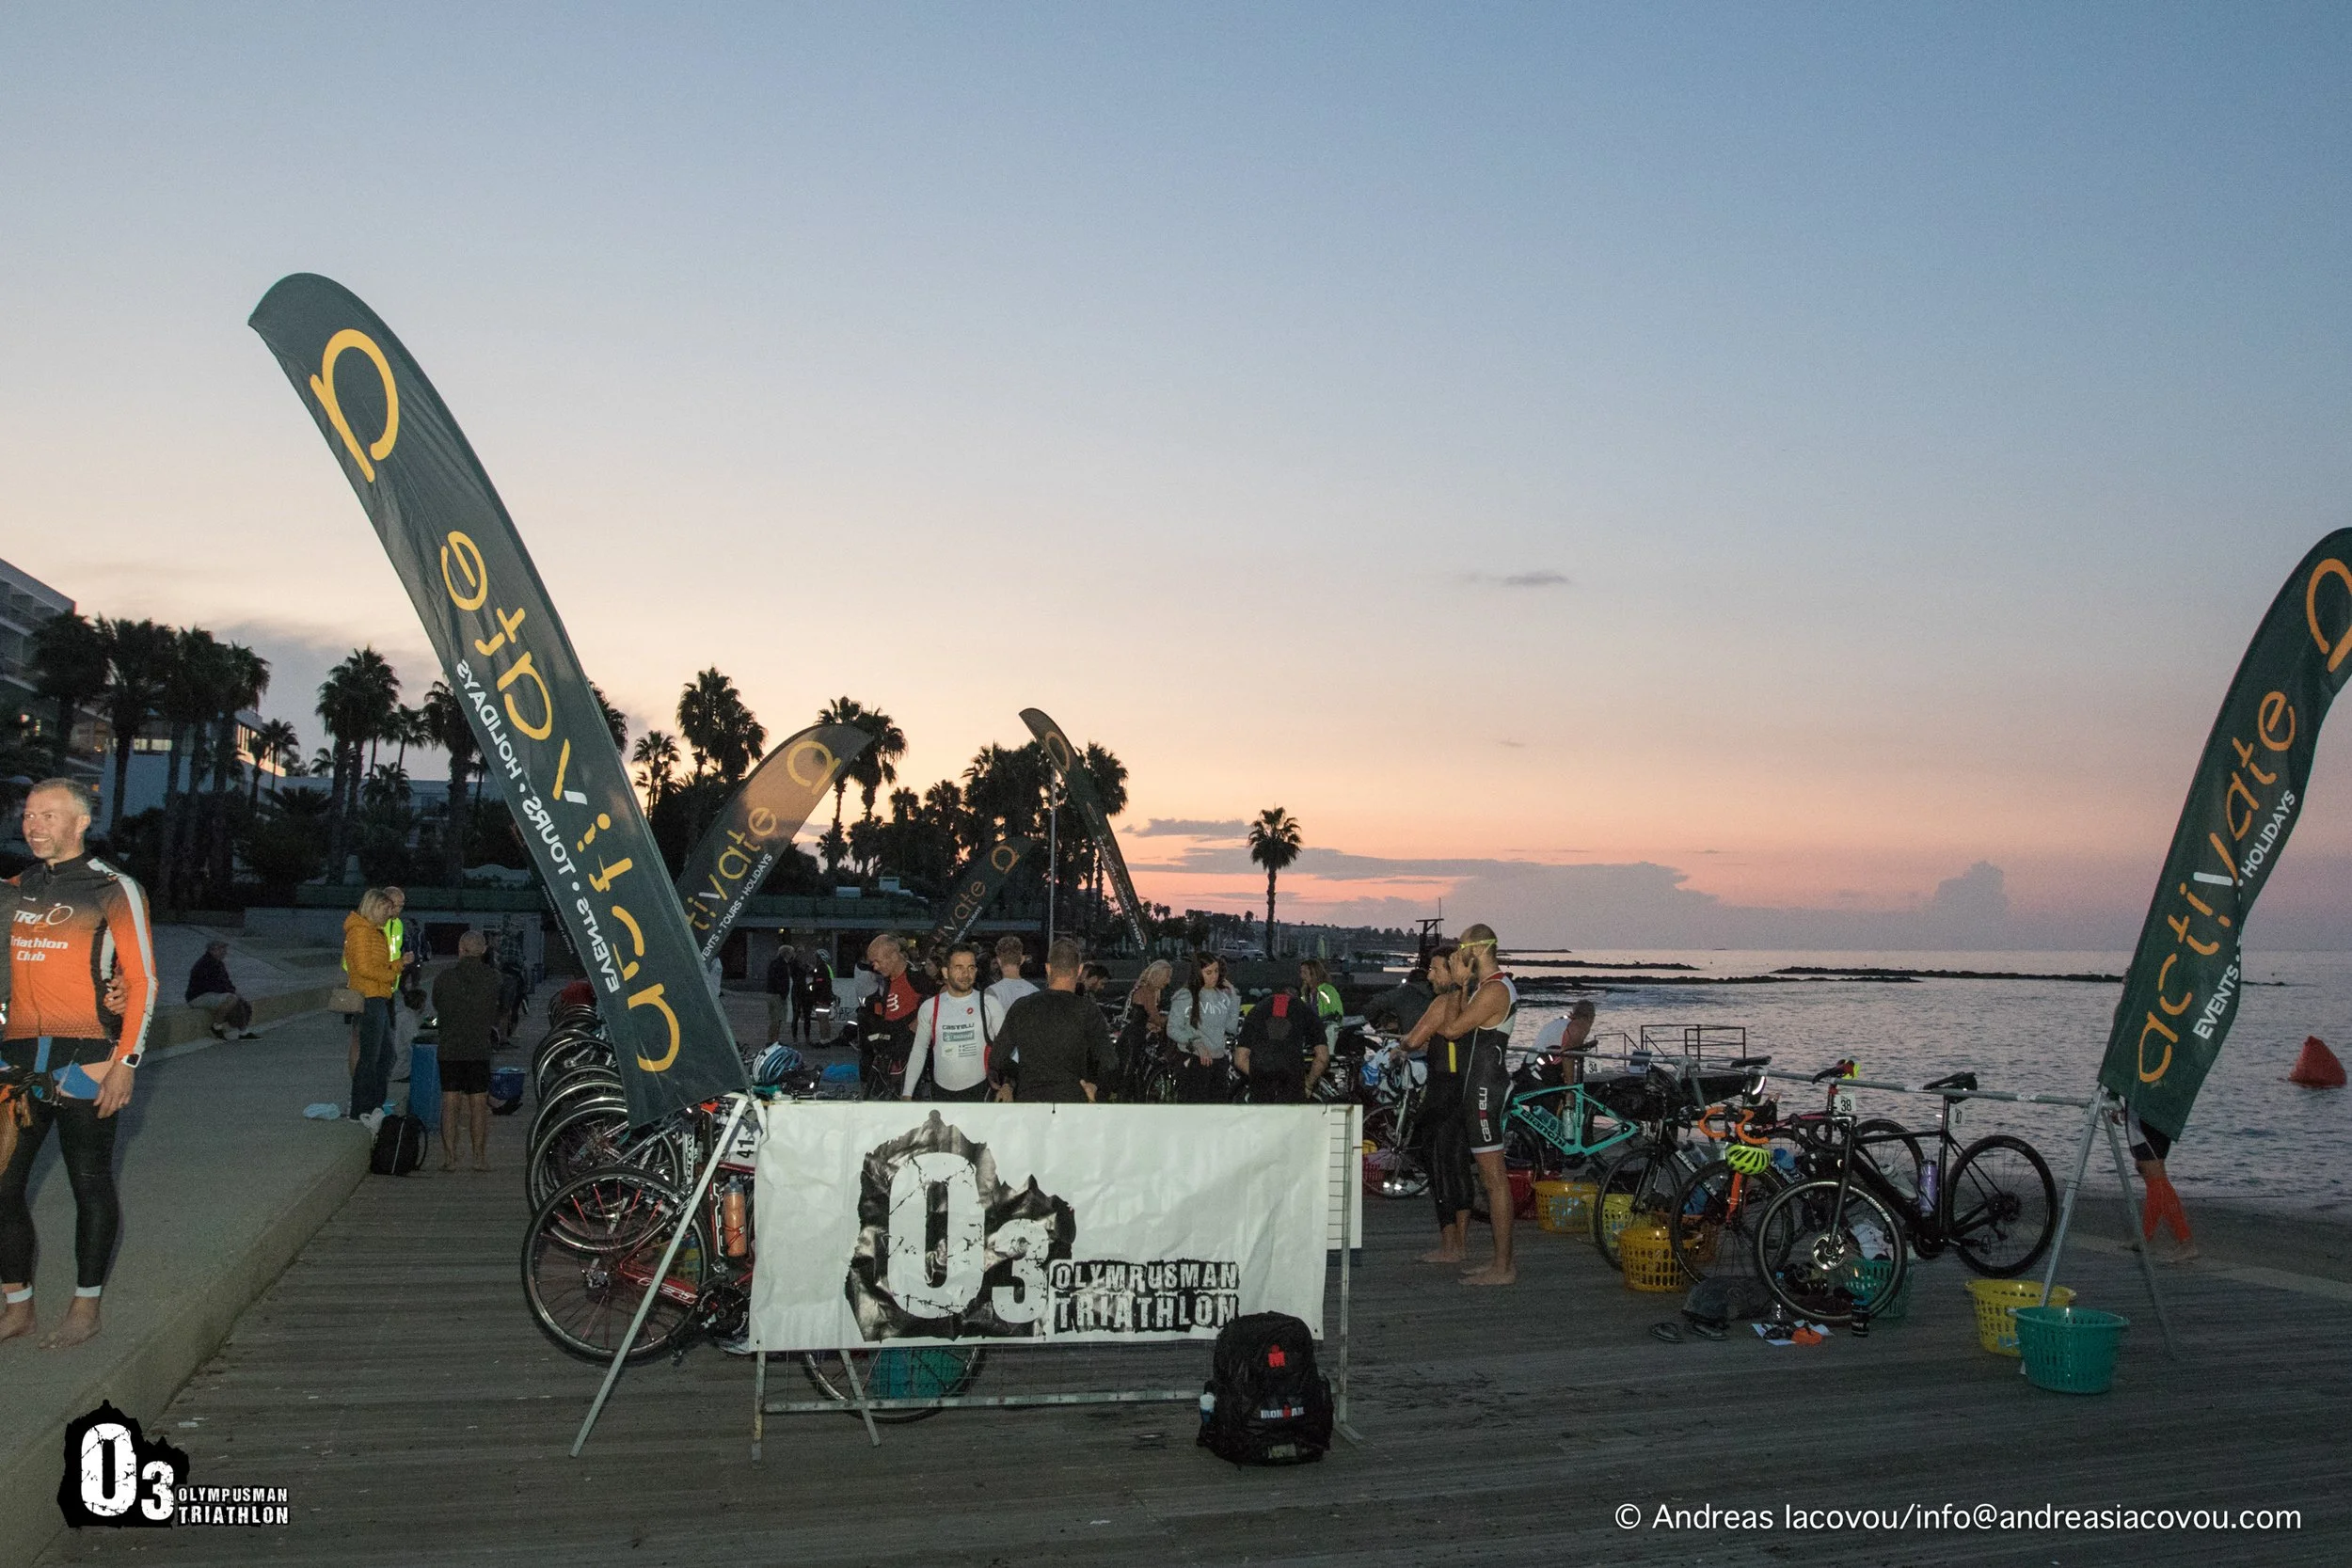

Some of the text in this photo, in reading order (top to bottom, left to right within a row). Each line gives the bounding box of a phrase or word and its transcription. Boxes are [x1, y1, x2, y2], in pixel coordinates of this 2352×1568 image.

[685, 807, 777, 930] tivate
[719, 900, 742, 928] TOURS
[742, 853, 773, 896] HOLIDAYS
[2192, 789, 2296, 1040] EVENTS HOLIDAYS
[16, 950, 45, 961] Club
[1589, 1062, 1597, 1073] 34
[1840, 1099, 1851, 1112] 38
[1520, 1110, 1568, 1148] Bianchi
[736, 1139, 755, 1159] 41
[1056, 1294, 1237, 1328] TRIATHLON
